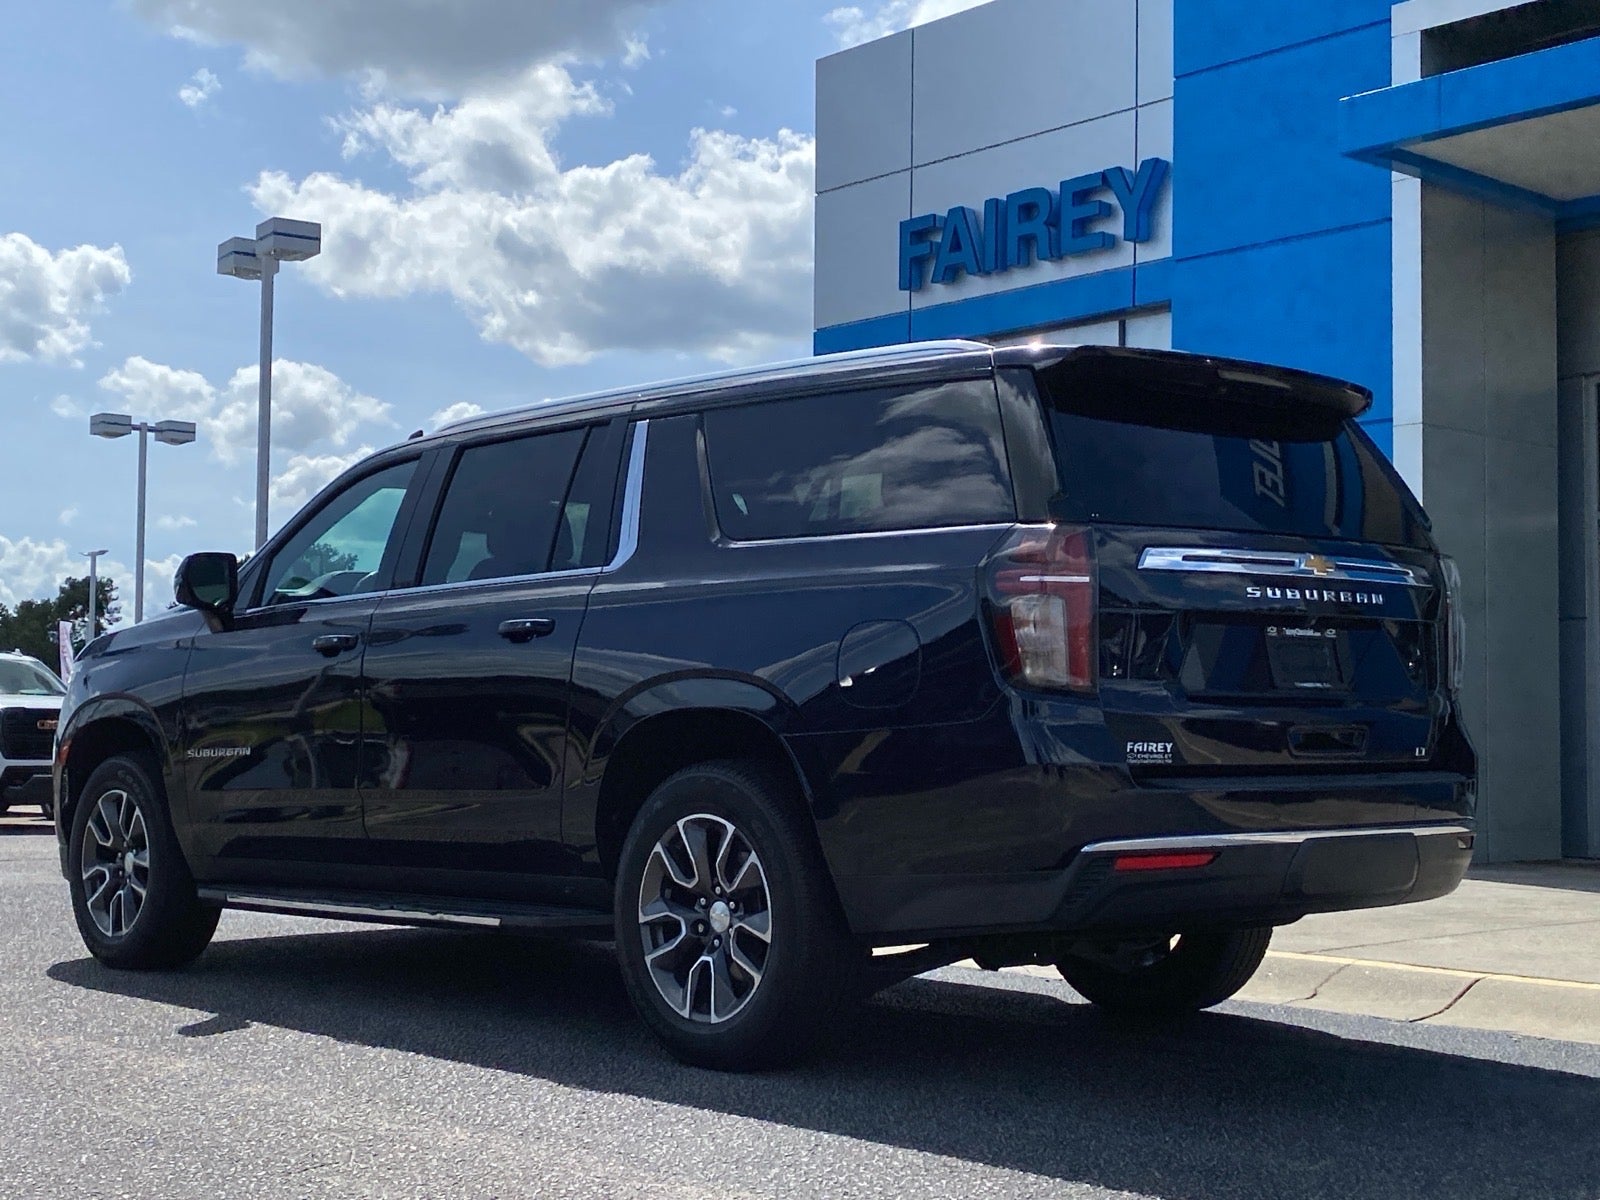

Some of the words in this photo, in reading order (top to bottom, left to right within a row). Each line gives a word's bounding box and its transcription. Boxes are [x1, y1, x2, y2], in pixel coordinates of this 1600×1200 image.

[899, 157, 1170, 291] FAIREY
[1246, 586, 1384, 605] SUBURBAN
[187, 746, 251, 758] SUBURBAN
[1126, 741, 1173, 753] FAIREY
